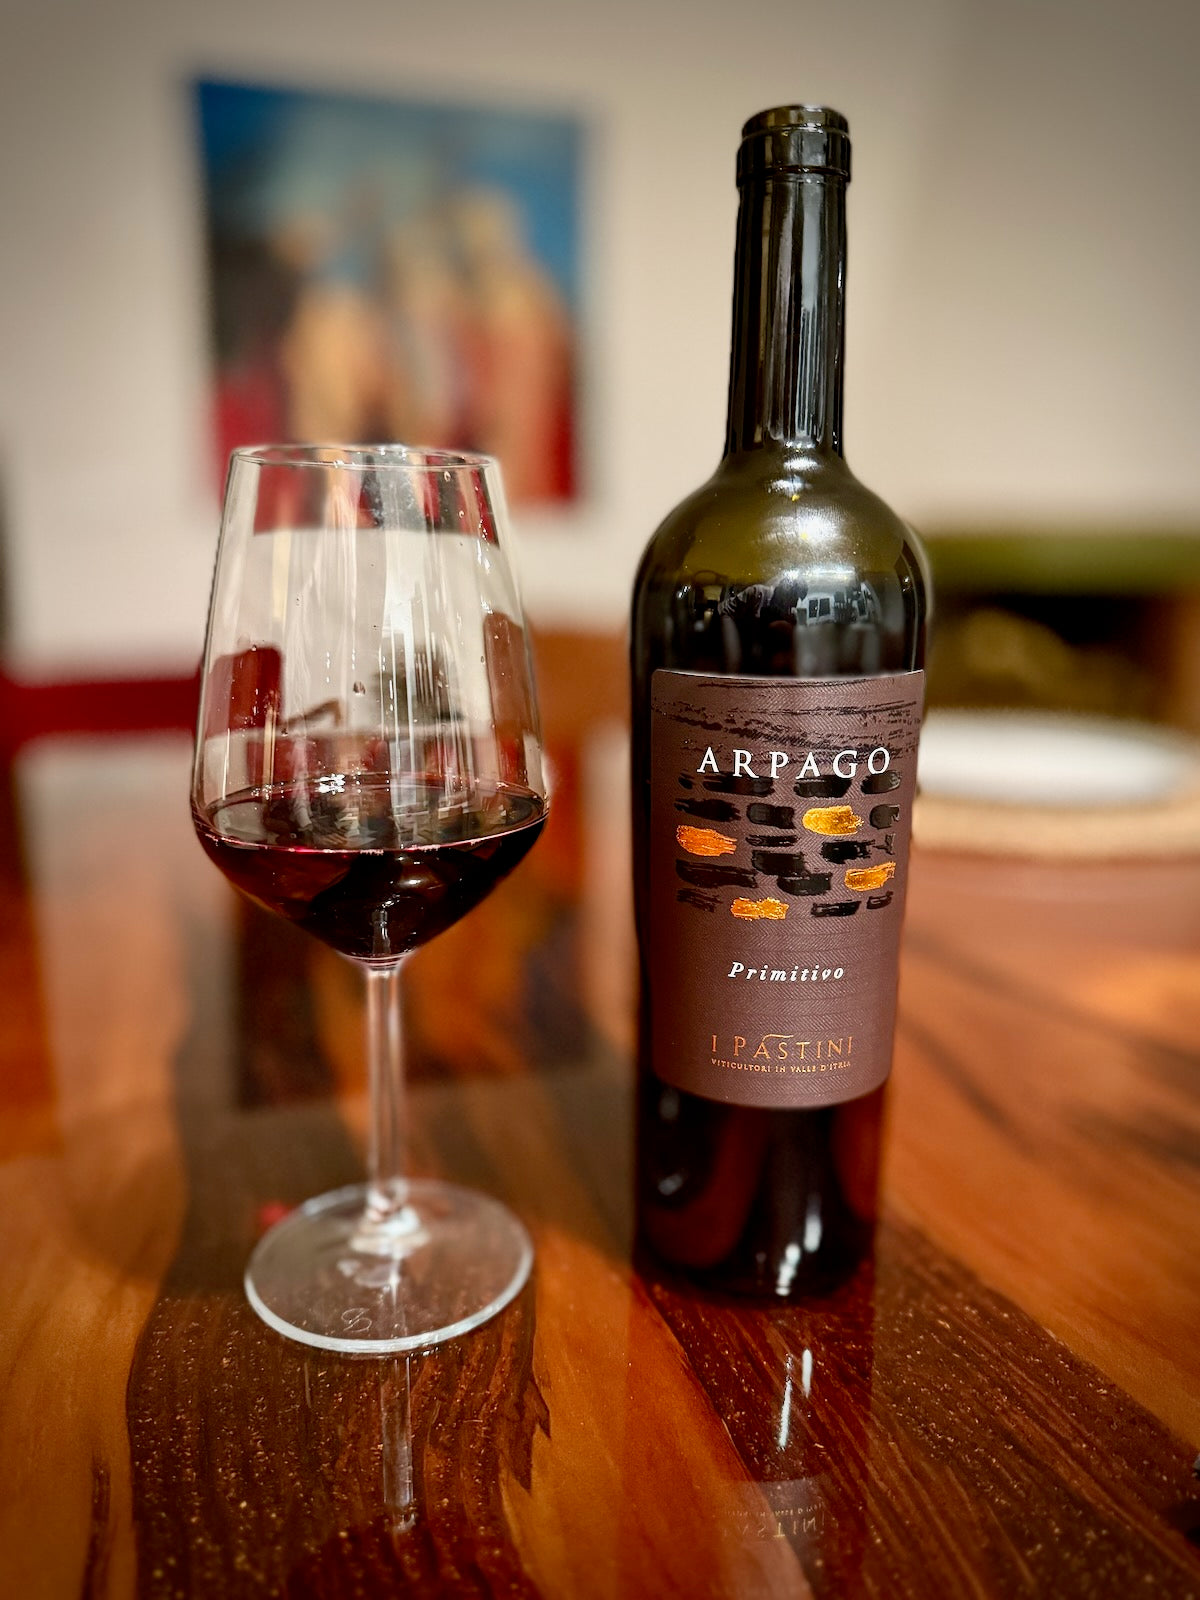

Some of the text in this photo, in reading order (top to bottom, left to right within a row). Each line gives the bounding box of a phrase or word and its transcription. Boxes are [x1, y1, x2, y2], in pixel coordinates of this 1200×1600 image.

[696, 746, 891, 780] ARPAGO
[727, 961, 845, 982] Primitivo
[711, 1033, 853, 1060] I PASTINI
[710, 1058, 851, 1073] VITICULTORI IN VALLE D'ITRIA
